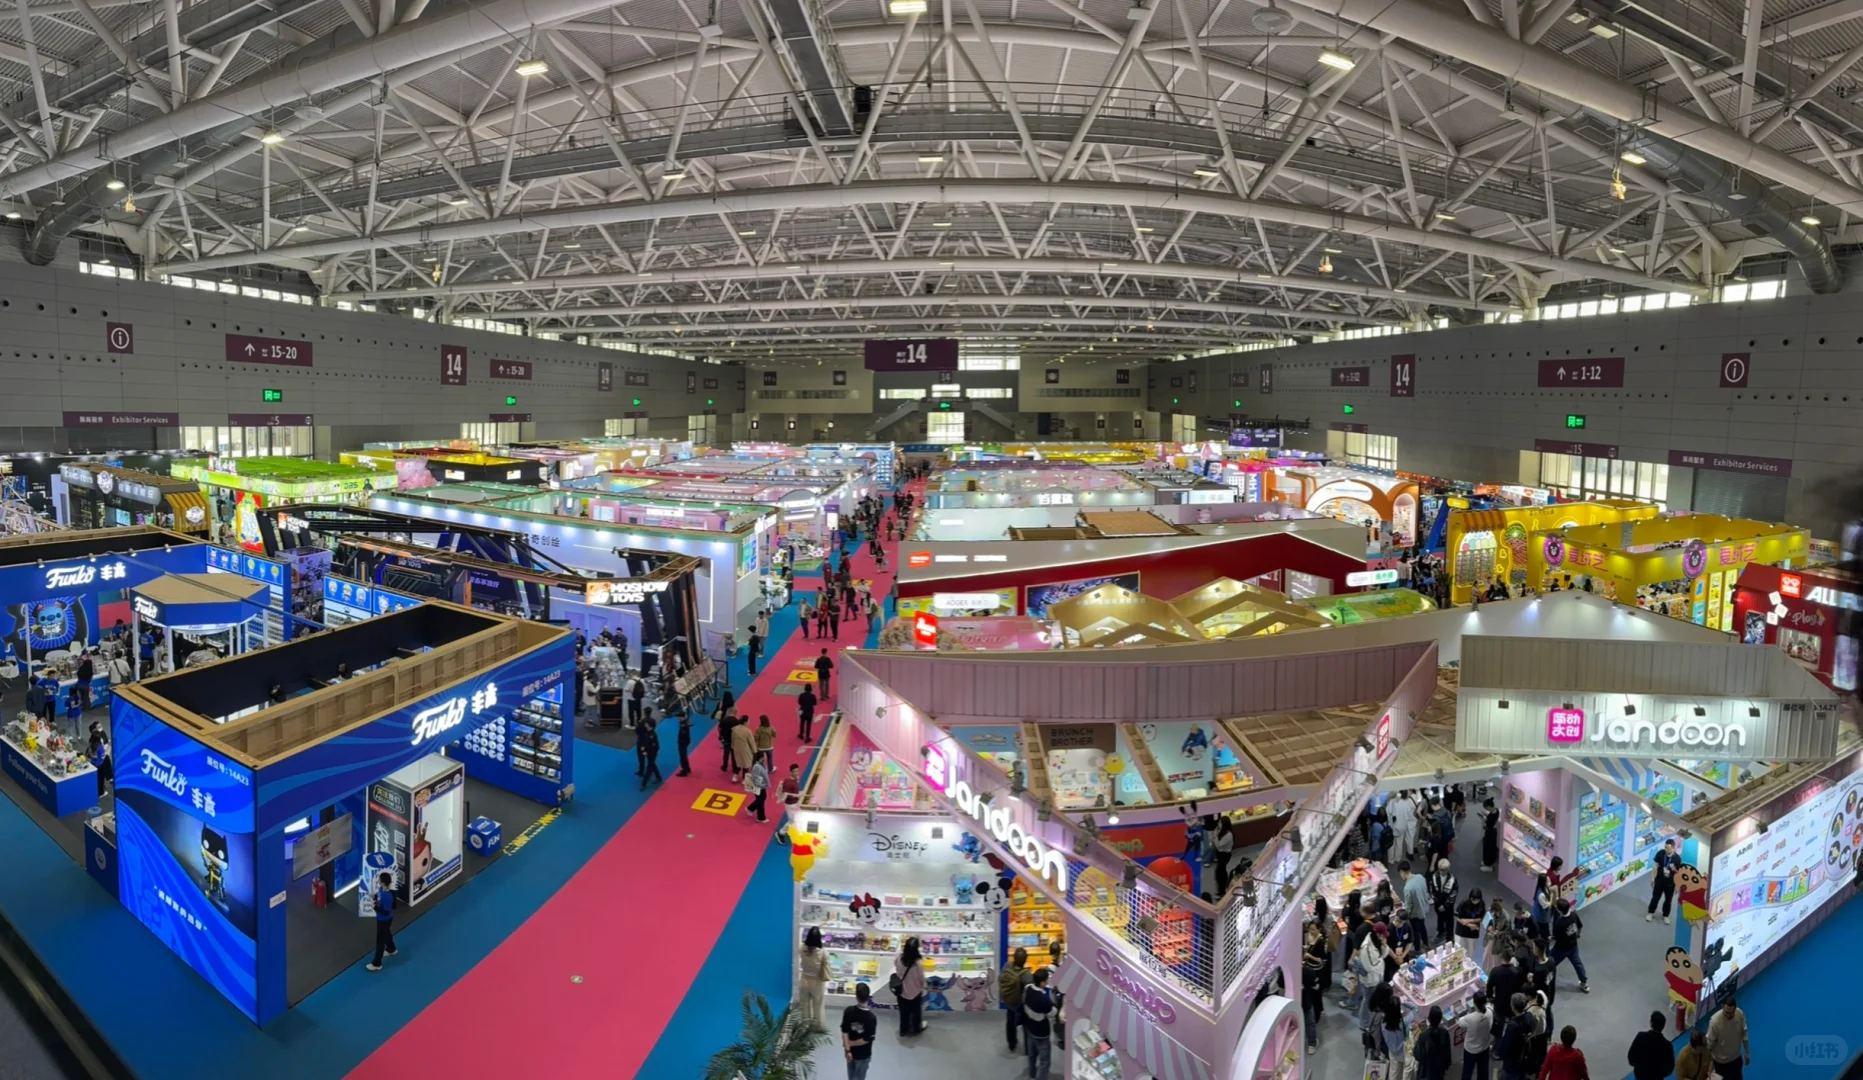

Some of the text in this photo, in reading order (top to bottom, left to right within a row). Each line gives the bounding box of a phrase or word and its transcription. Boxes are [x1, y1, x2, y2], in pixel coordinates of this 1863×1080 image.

[272, 345, 297, 360] 15-20
[907, 343, 928, 363] 14
[447, 354, 462, 376] 14
[1581, 366, 1602, 380] 1-12
[1262, 369, 1270, 386] 14
[1396, 363, 1410, 387] 14
[111, 416, 142, 424] Exhibitor
[143, 416, 168, 424] Services
[1574, 444, 1583, 455] 15
[1682, 455, 1778, 472] 展商服务 Exhibitor Services
[45, 564, 97, 589] Funko
[611, 582, 669, 593] MOSHOW
[611, 592, 645, 603] TOYS
[134, 596, 158, 619] Funko
[796, 671, 813, 680] C
[411, 697, 468, 746] Funko
[1590, 712, 1746, 746] Jandoon
[1051, 727, 1094, 737] BRUNCH
[1552, 724, 1580, 737] 文创
[1051, 737, 1093, 747] BROTHER
[140, 748, 187, 796] Funko
[704, 792, 733, 810] B
[945, 765, 1067, 892] Jandoon
[1096, 947, 1176, 1024] Sanrio
[1112, 983, 1157, 1023] LICENSE
